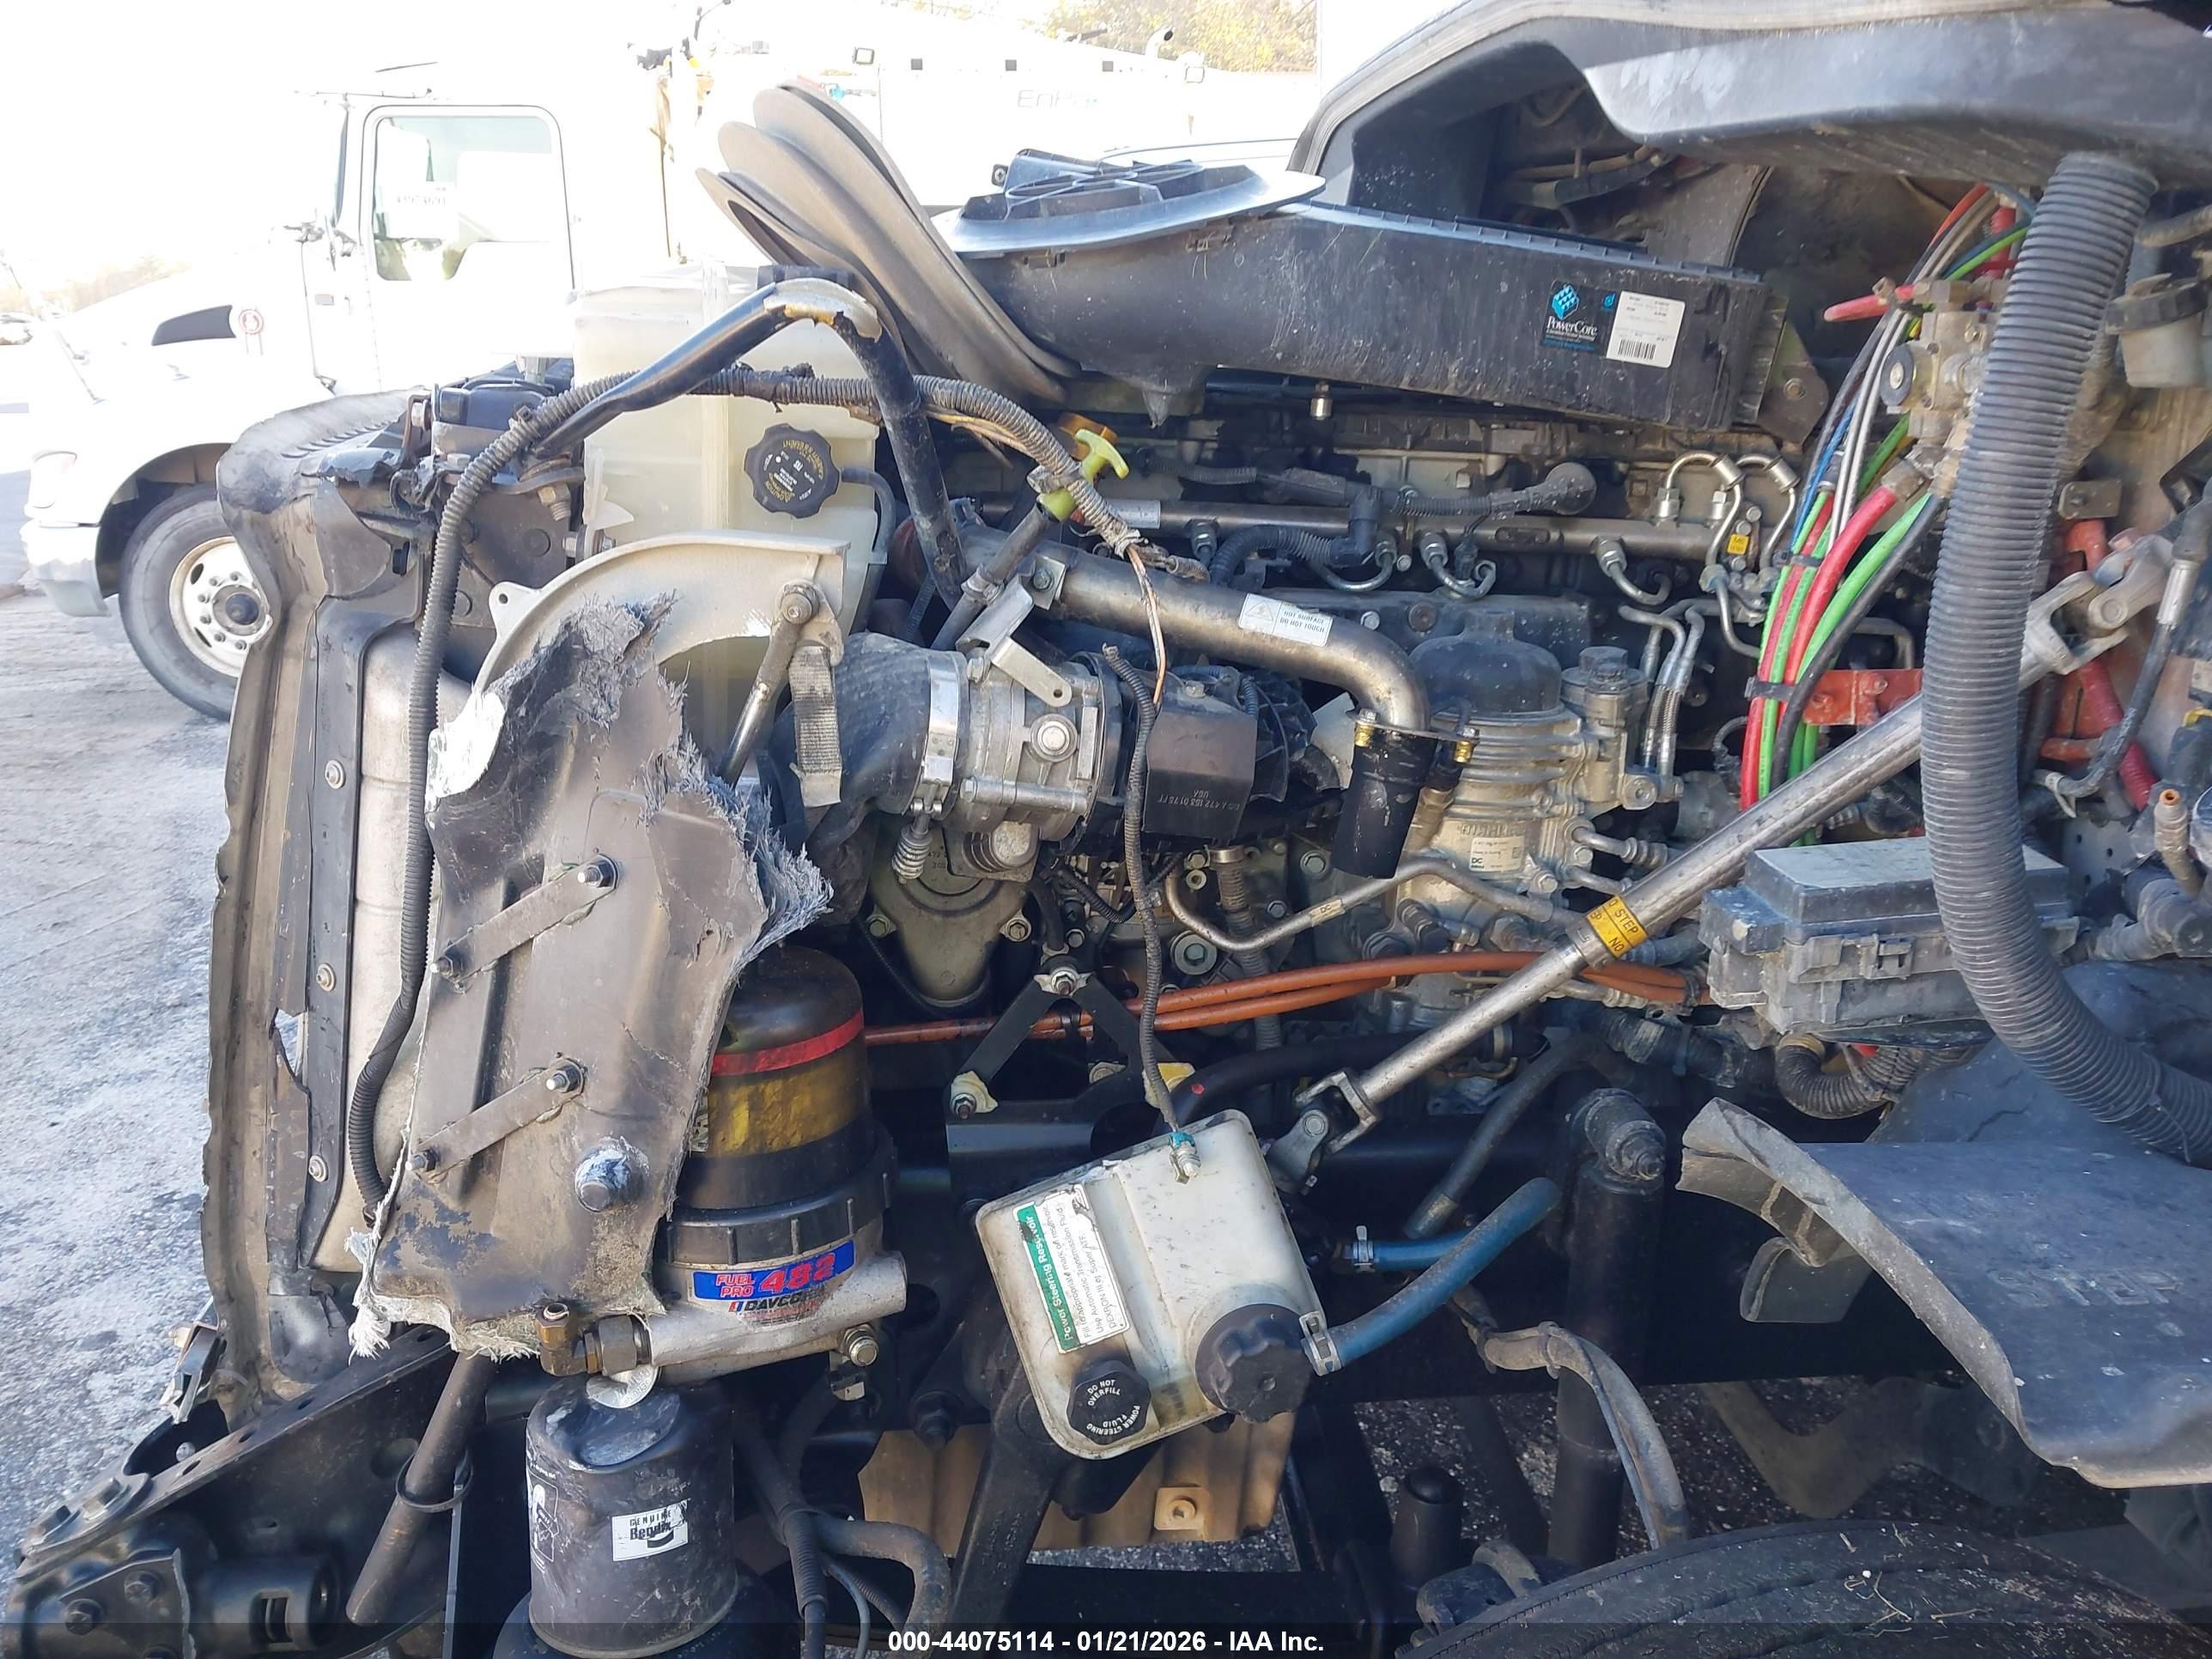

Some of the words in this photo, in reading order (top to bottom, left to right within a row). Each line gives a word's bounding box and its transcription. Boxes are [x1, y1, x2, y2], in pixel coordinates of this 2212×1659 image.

[1547, 315, 1598, 336] PowerCore
[1290, 619, 1303, 628] NOT
[1305, 623, 1325, 633] TOUCH
[1614, 908, 1639, 933] STEP
[1608, 937, 1626, 951] NO
[1057, 1251, 1069, 1271] mark
[1065, 1226, 1085, 1277] Transmission
[757, 1253, 836, 1292] 482
[1085, 1251, 1099, 1274] Super
[716, 1273, 756, 1286] FUEL
[1042, 1263, 1063, 1307] Steering
[720, 1285, 754, 1298] PRO
[744, 1291, 803, 1311] DAVCO
[1081, 1277, 1099, 1316] Automatic
[1100, 1293, 1117, 1329] DEXRON
[1057, 1308, 1073, 1340] Power
[1095, 1317, 1104, 1334] Use
[1087, 1384, 1098, 1395] DO
[1099, 1379, 1115, 1388] NOT
[1087, 1387, 1121, 1407] OVERFILL
[1103, 1413, 1127, 1428] FLUID
[1121, 1405, 1140, 1429] POWER
[1086, 1423, 1123, 1436] STEERING
[629, 1520, 672, 1540] Bendix
